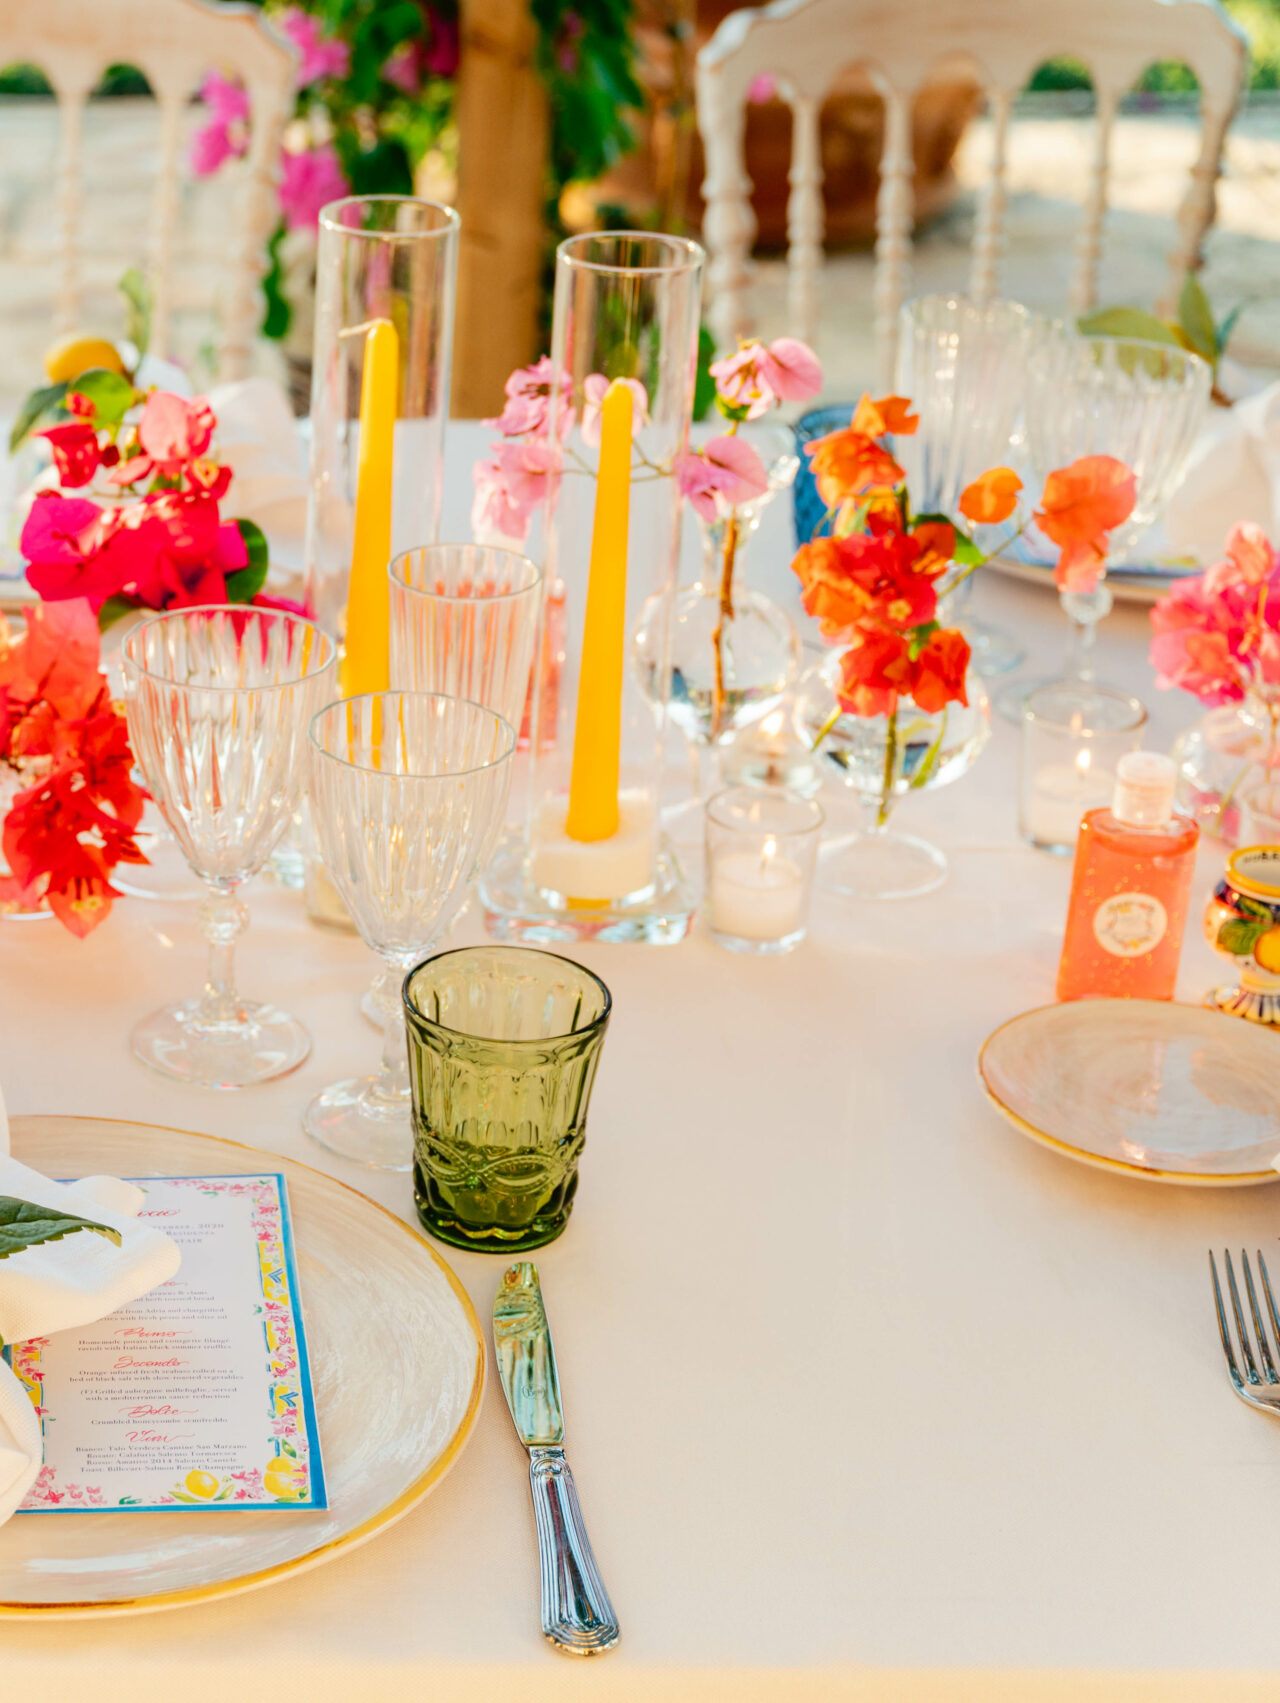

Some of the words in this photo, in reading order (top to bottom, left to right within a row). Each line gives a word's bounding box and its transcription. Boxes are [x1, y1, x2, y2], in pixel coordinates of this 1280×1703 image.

[114, 1356, 189, 1369] Secondo
[118, 1404, 198, 1418] Dolce
[125, 1430, 195, 1442] Vini
